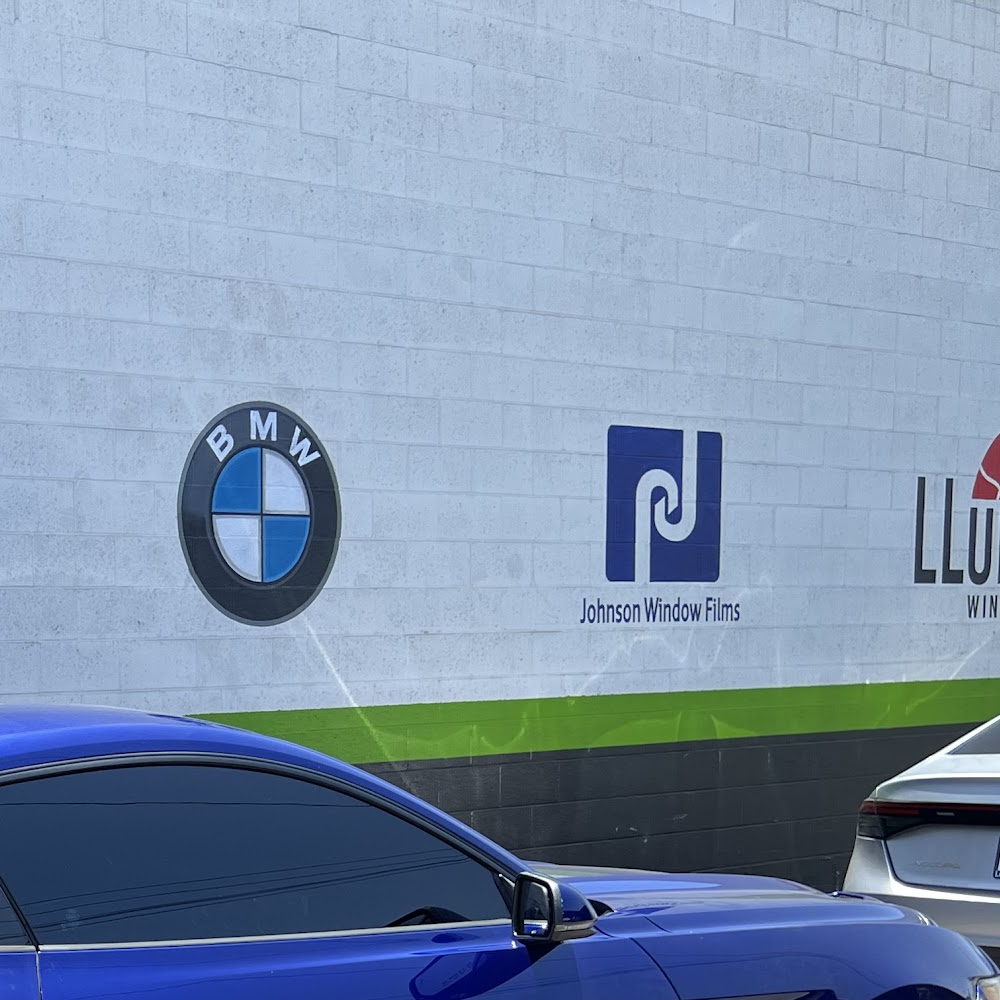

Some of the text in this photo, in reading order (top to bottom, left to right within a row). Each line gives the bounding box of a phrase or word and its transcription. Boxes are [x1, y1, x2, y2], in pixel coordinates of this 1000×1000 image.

[206, 409, 322, 467] BMW
[914, 476, 1000, 585] LLU
[579, 596, 741, 624] Johnson Window Films
